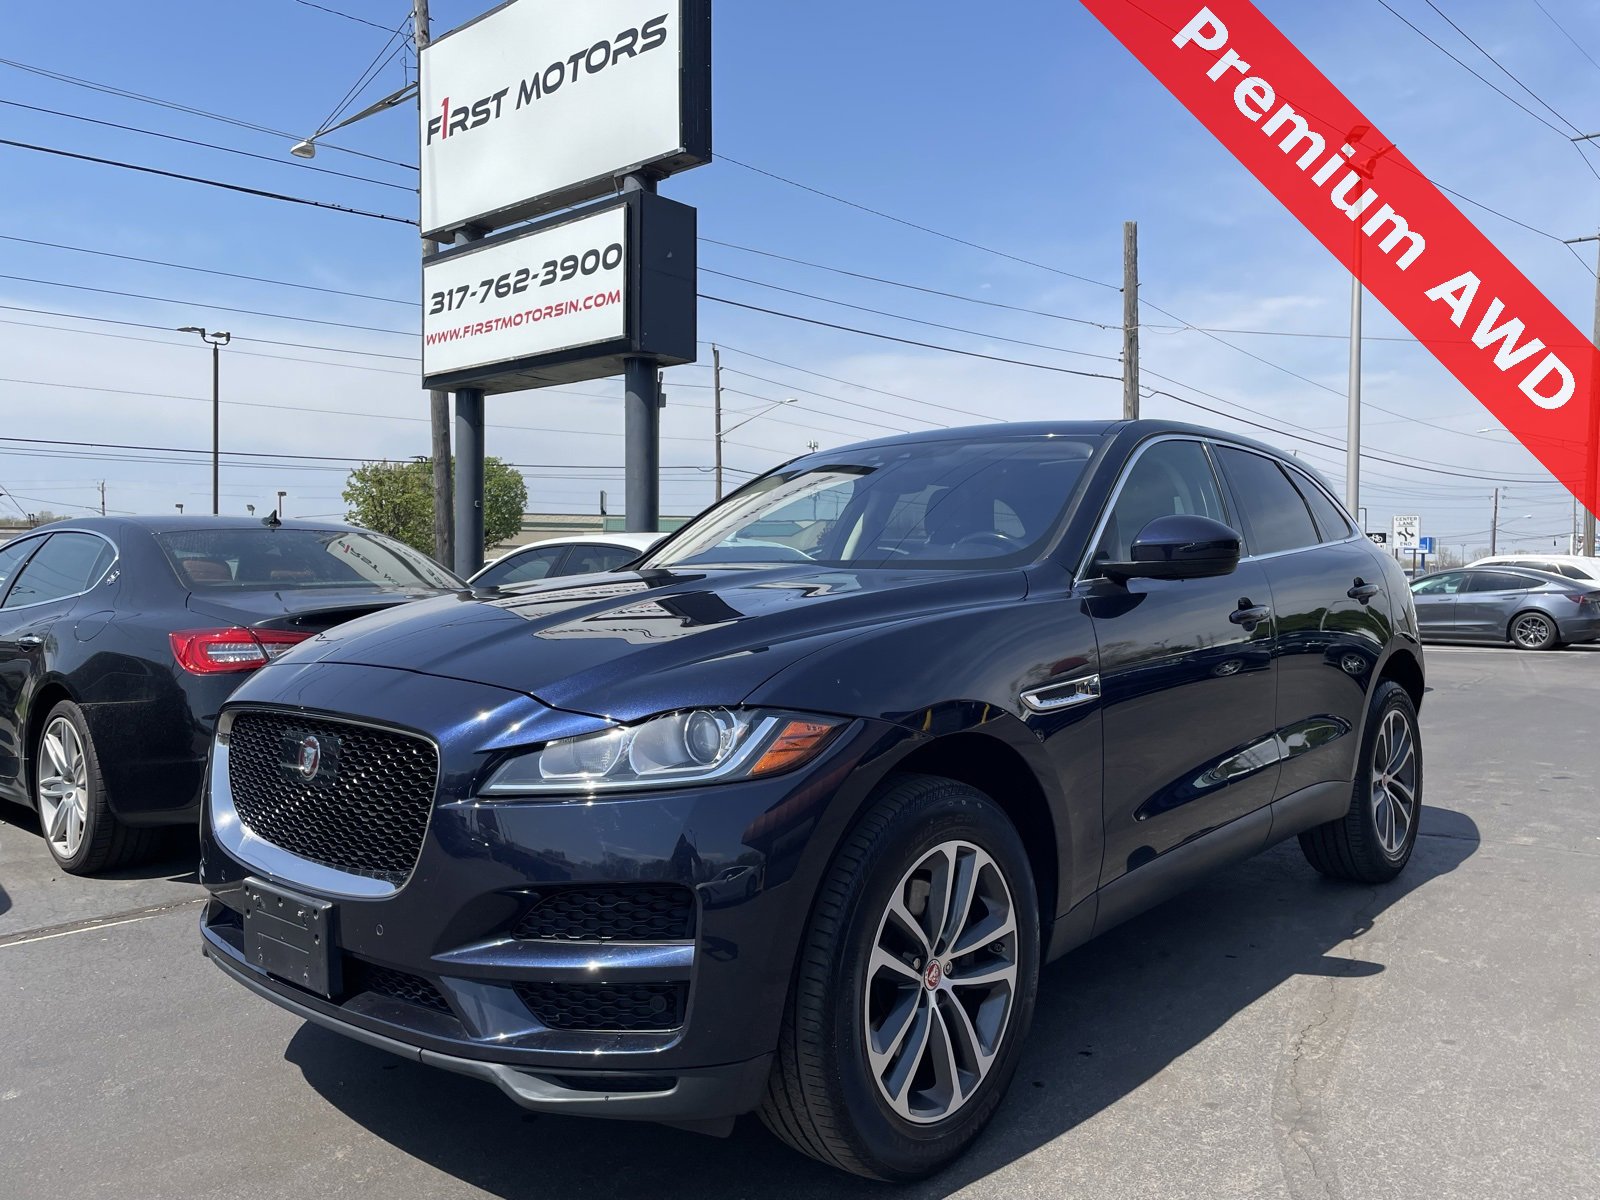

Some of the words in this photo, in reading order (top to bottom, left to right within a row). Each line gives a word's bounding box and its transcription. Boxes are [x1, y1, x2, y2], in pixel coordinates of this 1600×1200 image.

[515, 13, 669, 110] MOTORS
[429, 243, 623, 315] 317-762-3900
[426, 290, 621, 346] WWW.FIRSTMOTORSIN.COM
